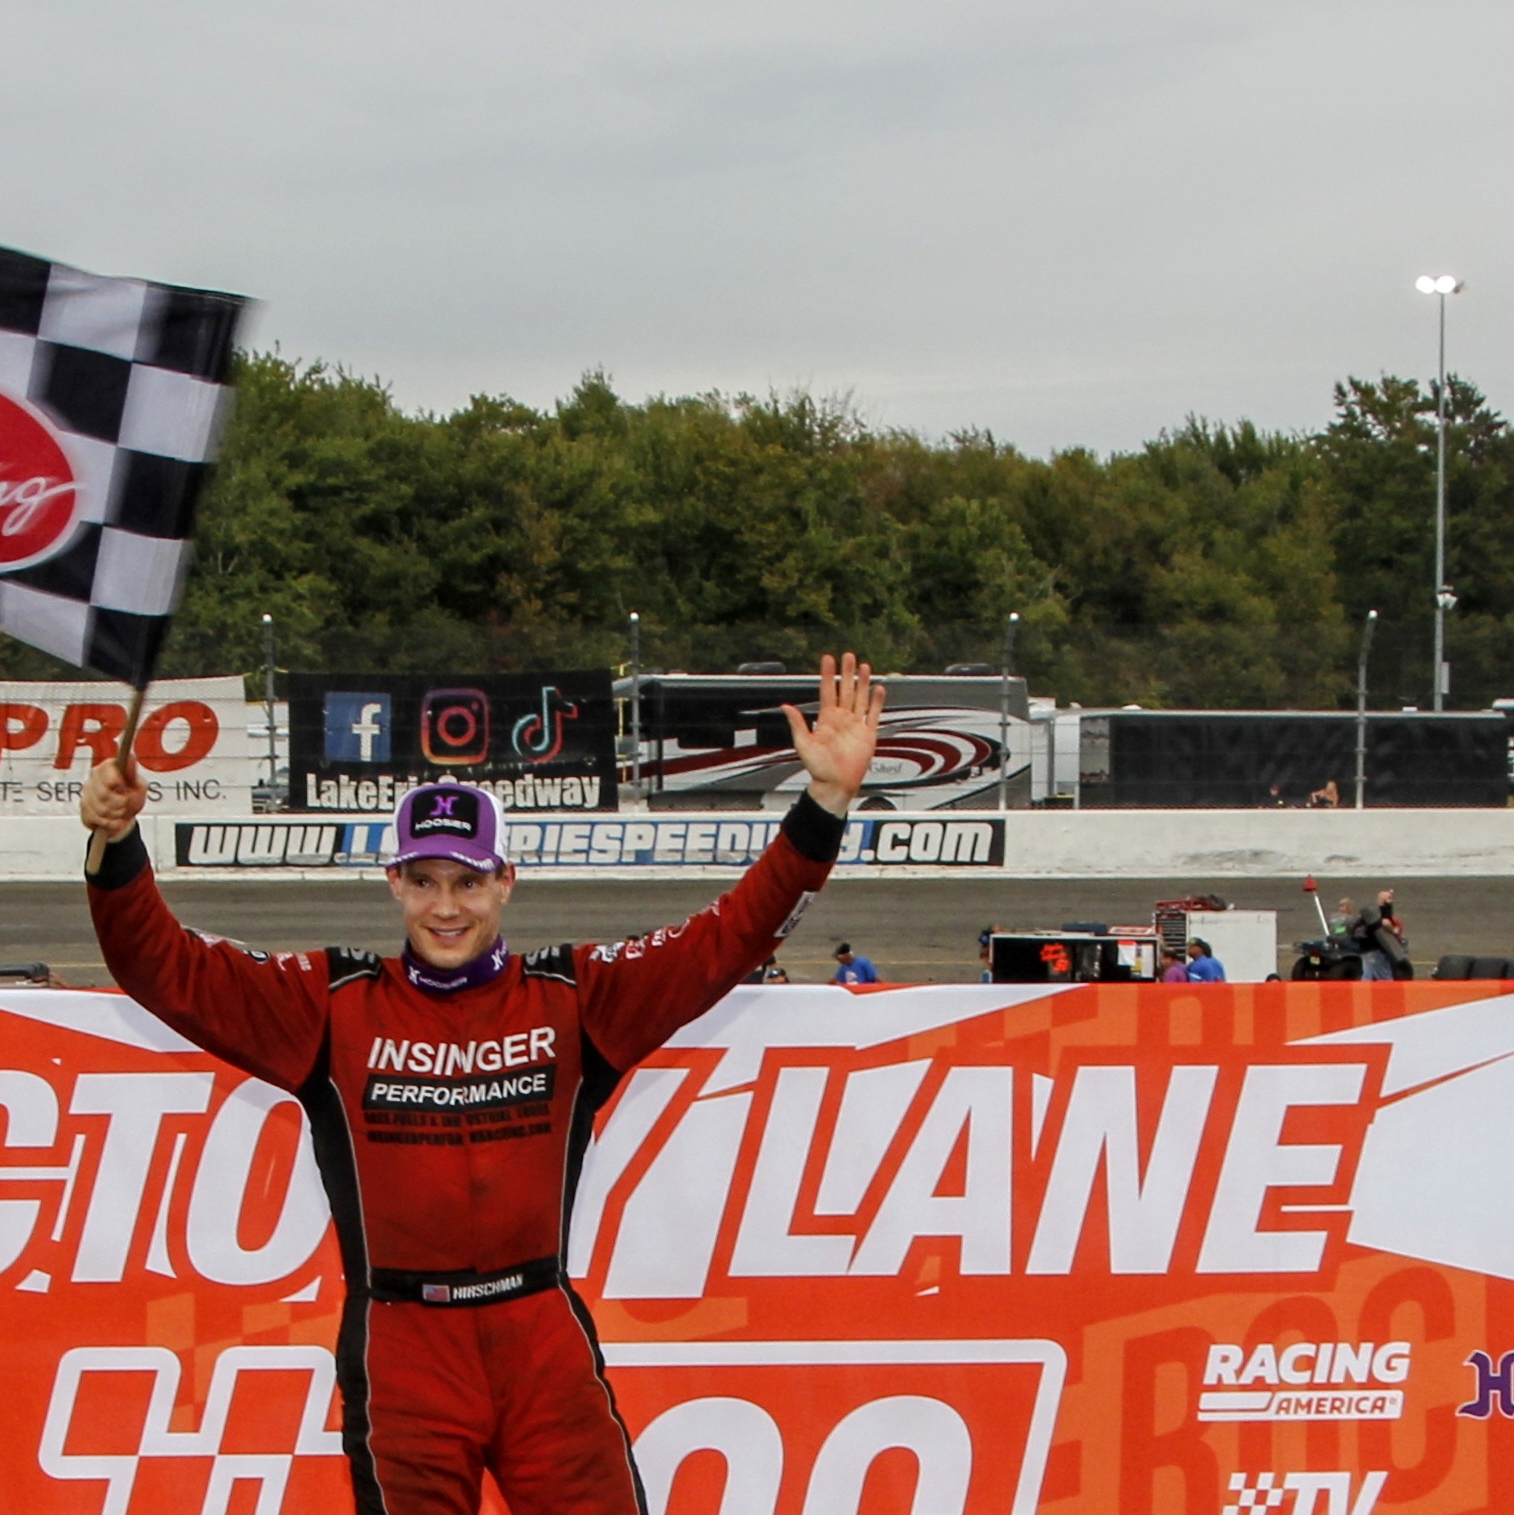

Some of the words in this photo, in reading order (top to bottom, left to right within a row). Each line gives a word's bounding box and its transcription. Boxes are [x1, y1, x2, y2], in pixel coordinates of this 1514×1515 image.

[176, 779, 227, 801] INC.
[367, 1026, 557, 1076] INSINGER
[371, 1073, 547, 1106] PERFORMANCE
[729, 1064, 1366, 1277] LANE
[453, 1274, 524, 1300] HIRSCHMAN
[1203, 1342, 1411, 1385] RACING
